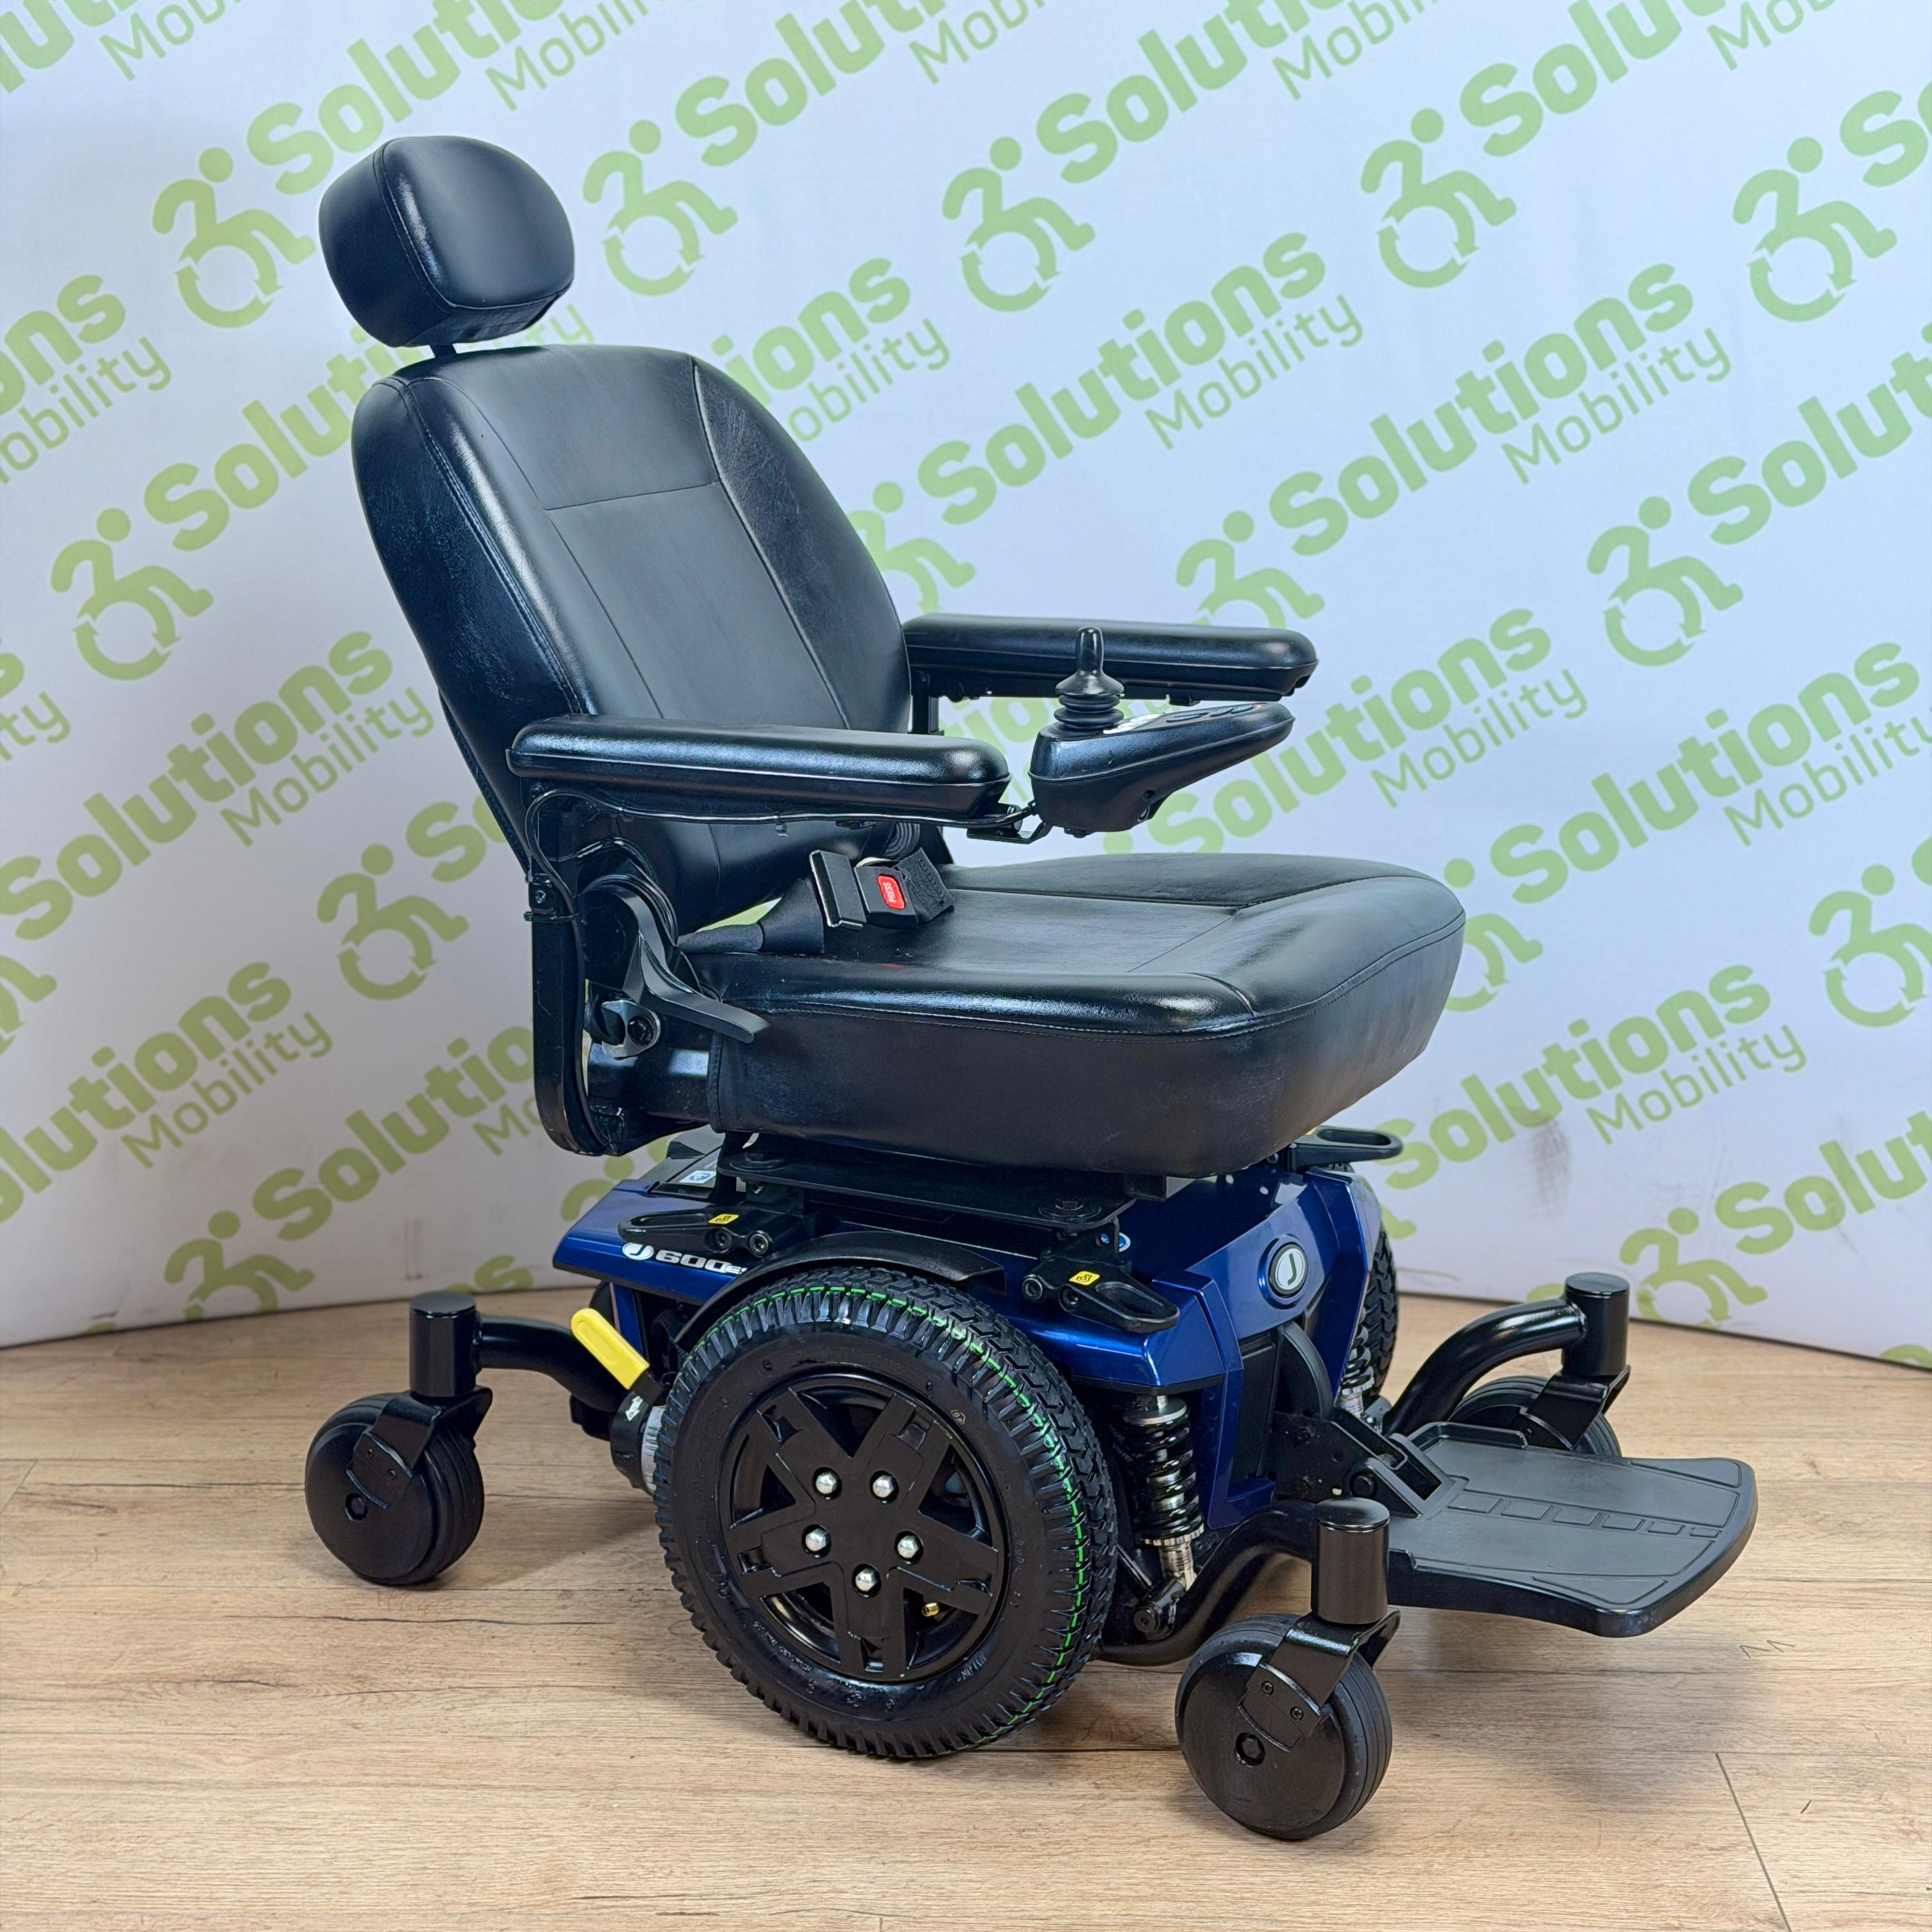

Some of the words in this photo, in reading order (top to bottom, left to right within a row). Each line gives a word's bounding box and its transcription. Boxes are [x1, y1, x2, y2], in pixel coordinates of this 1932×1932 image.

[0, 336, 172, 484] obility
[788, 318, 950, 441] obility
[917, 233, 1324, 525] Solutions
[1145, 295, 1363, 450] Mobility
[1268, 264, 1693, 556] Solutions
[1500, 327, 1731, 485] Mobility
[1688, 322, 1932, 546] Solut
[0, 631, 393, 942] Solutions
[220, 687, 434, 847] Mobility
[1147, 608, 1552, 853] Solutions
[1370, 670, 1588, 809] Mobility
[1490, 642, 1919, 904] Solutions
[122, 1011, 333, 1169] Mobility
[252, 1026, 534, 1241] Solutio
[1374, 965, 1771, 1190] Solutions
[1586, 1024, 1807, 1145] Mobility
